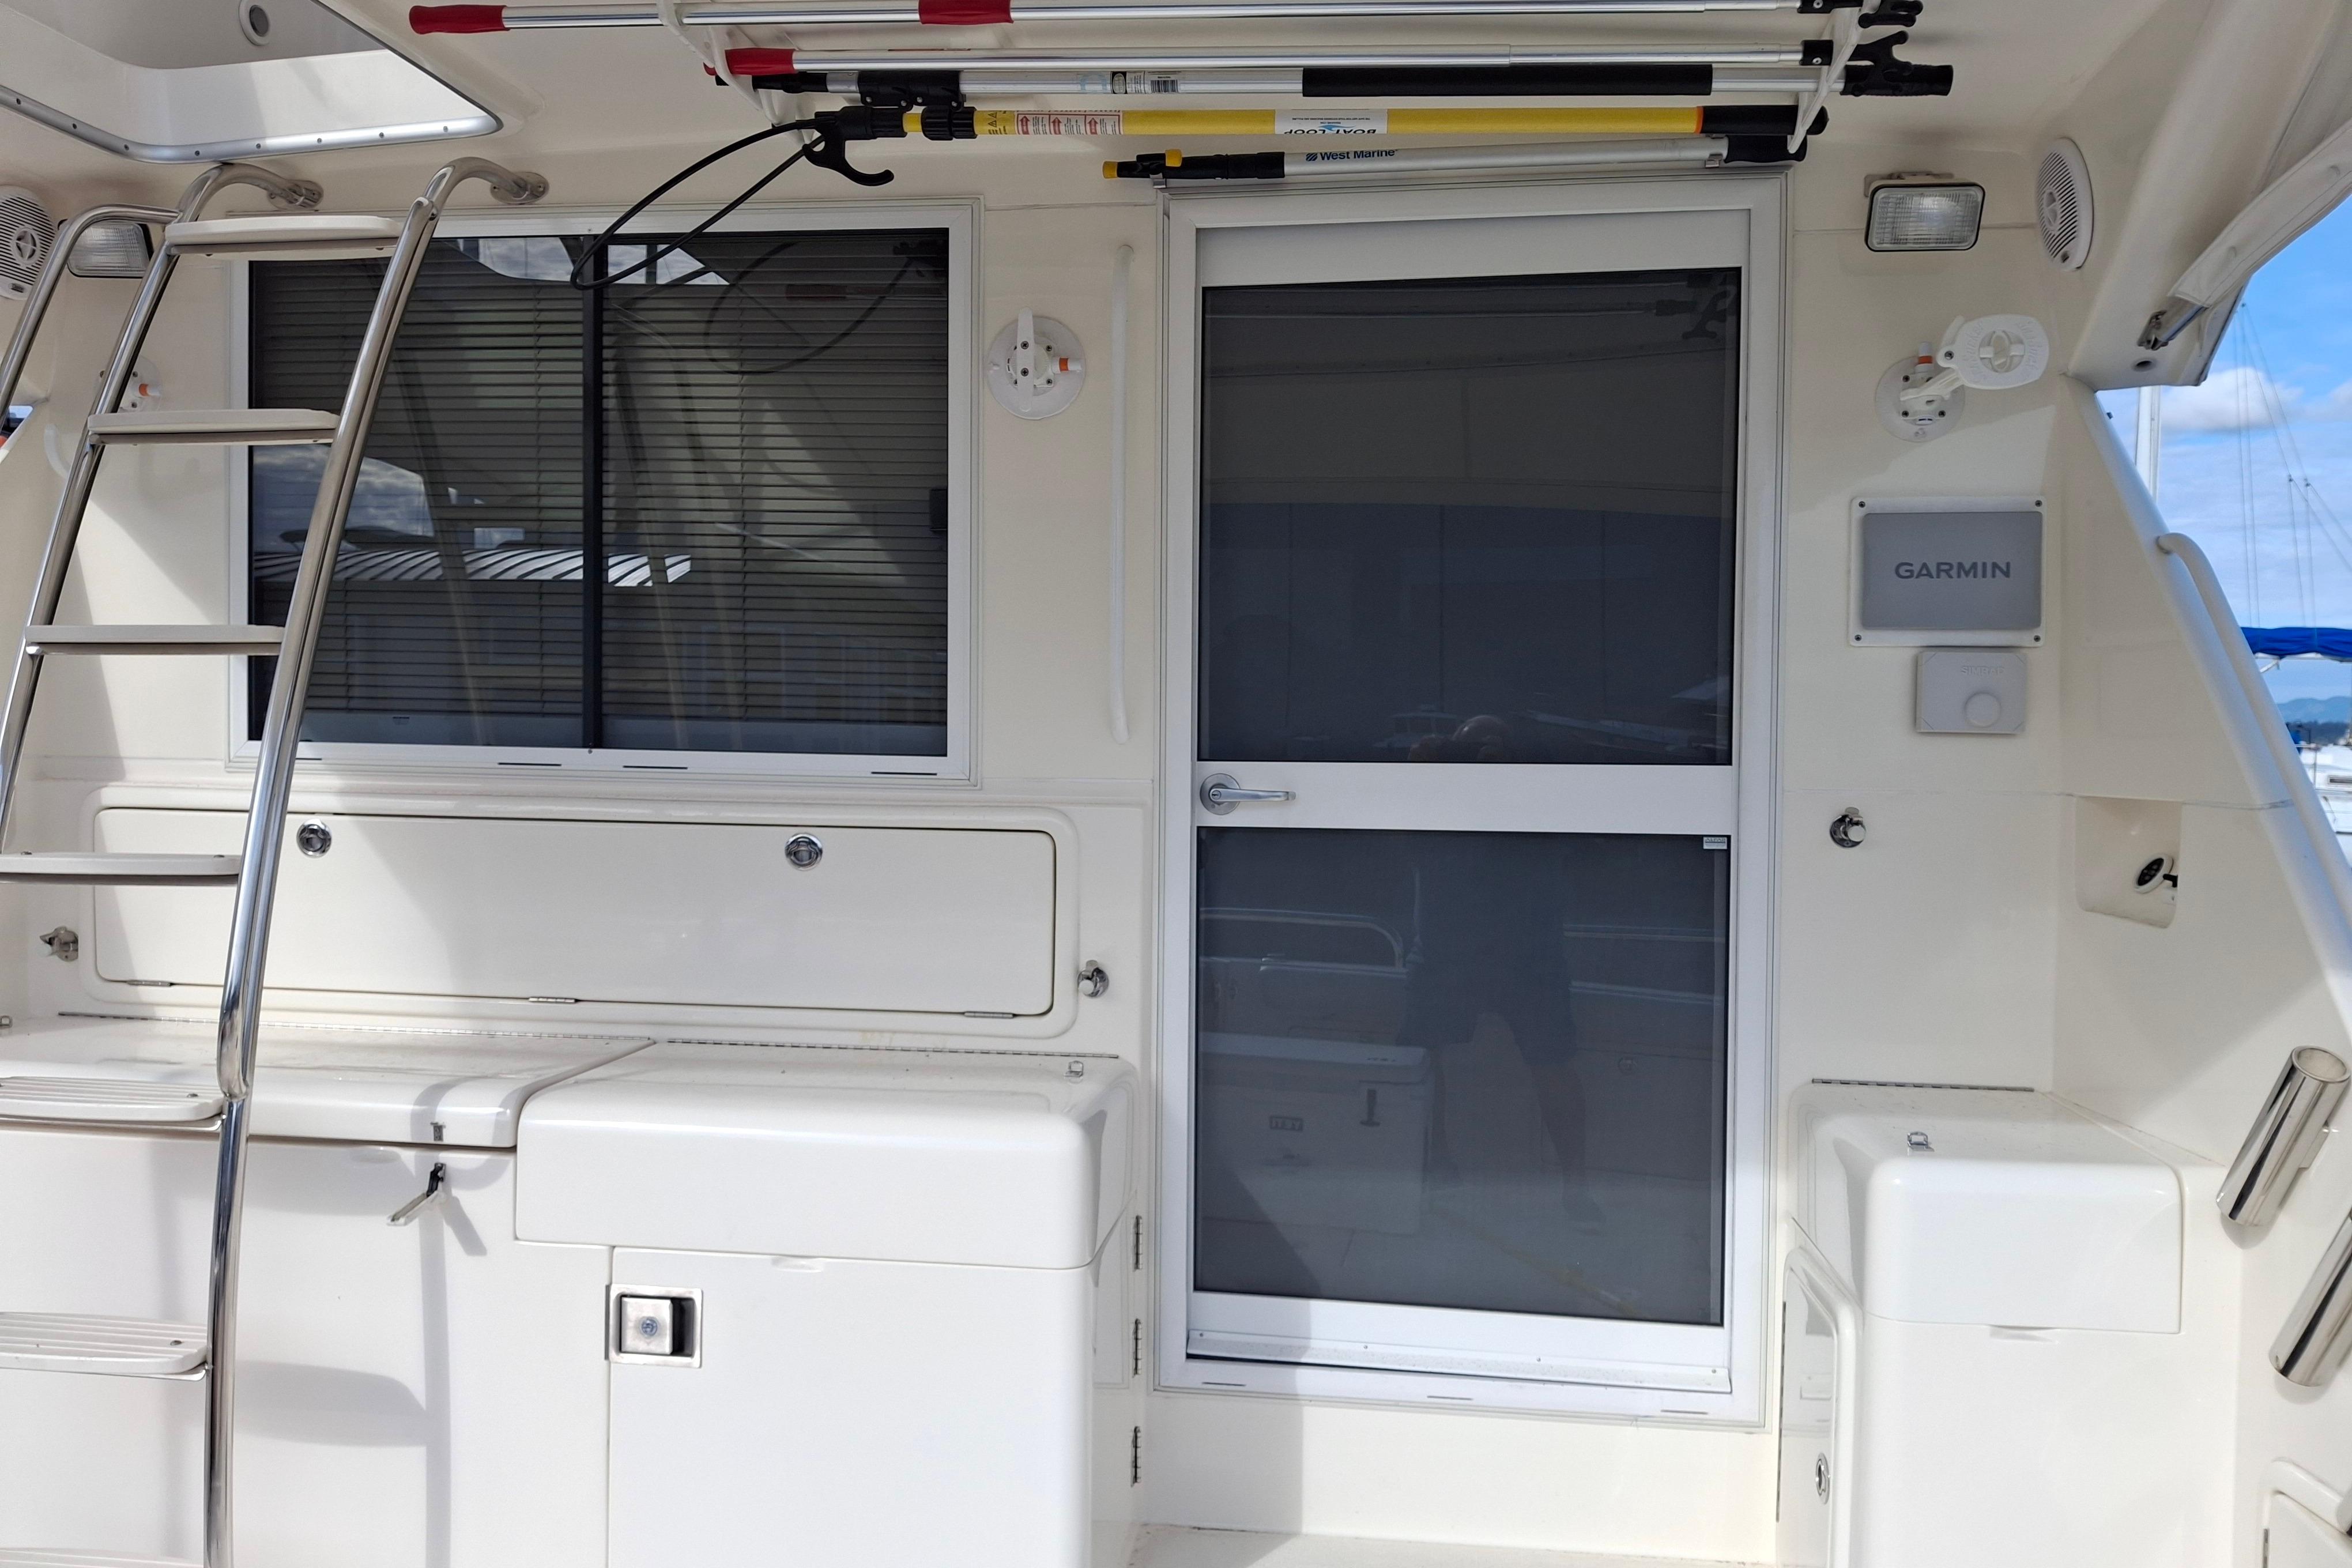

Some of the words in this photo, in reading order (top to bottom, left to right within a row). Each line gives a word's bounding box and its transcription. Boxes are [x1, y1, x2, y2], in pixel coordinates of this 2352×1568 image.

[1320, 151, 1351, 160] West
[1353, 149, 1395, 159] Marine
[1894, 561, 2011, 579] GARMIN
